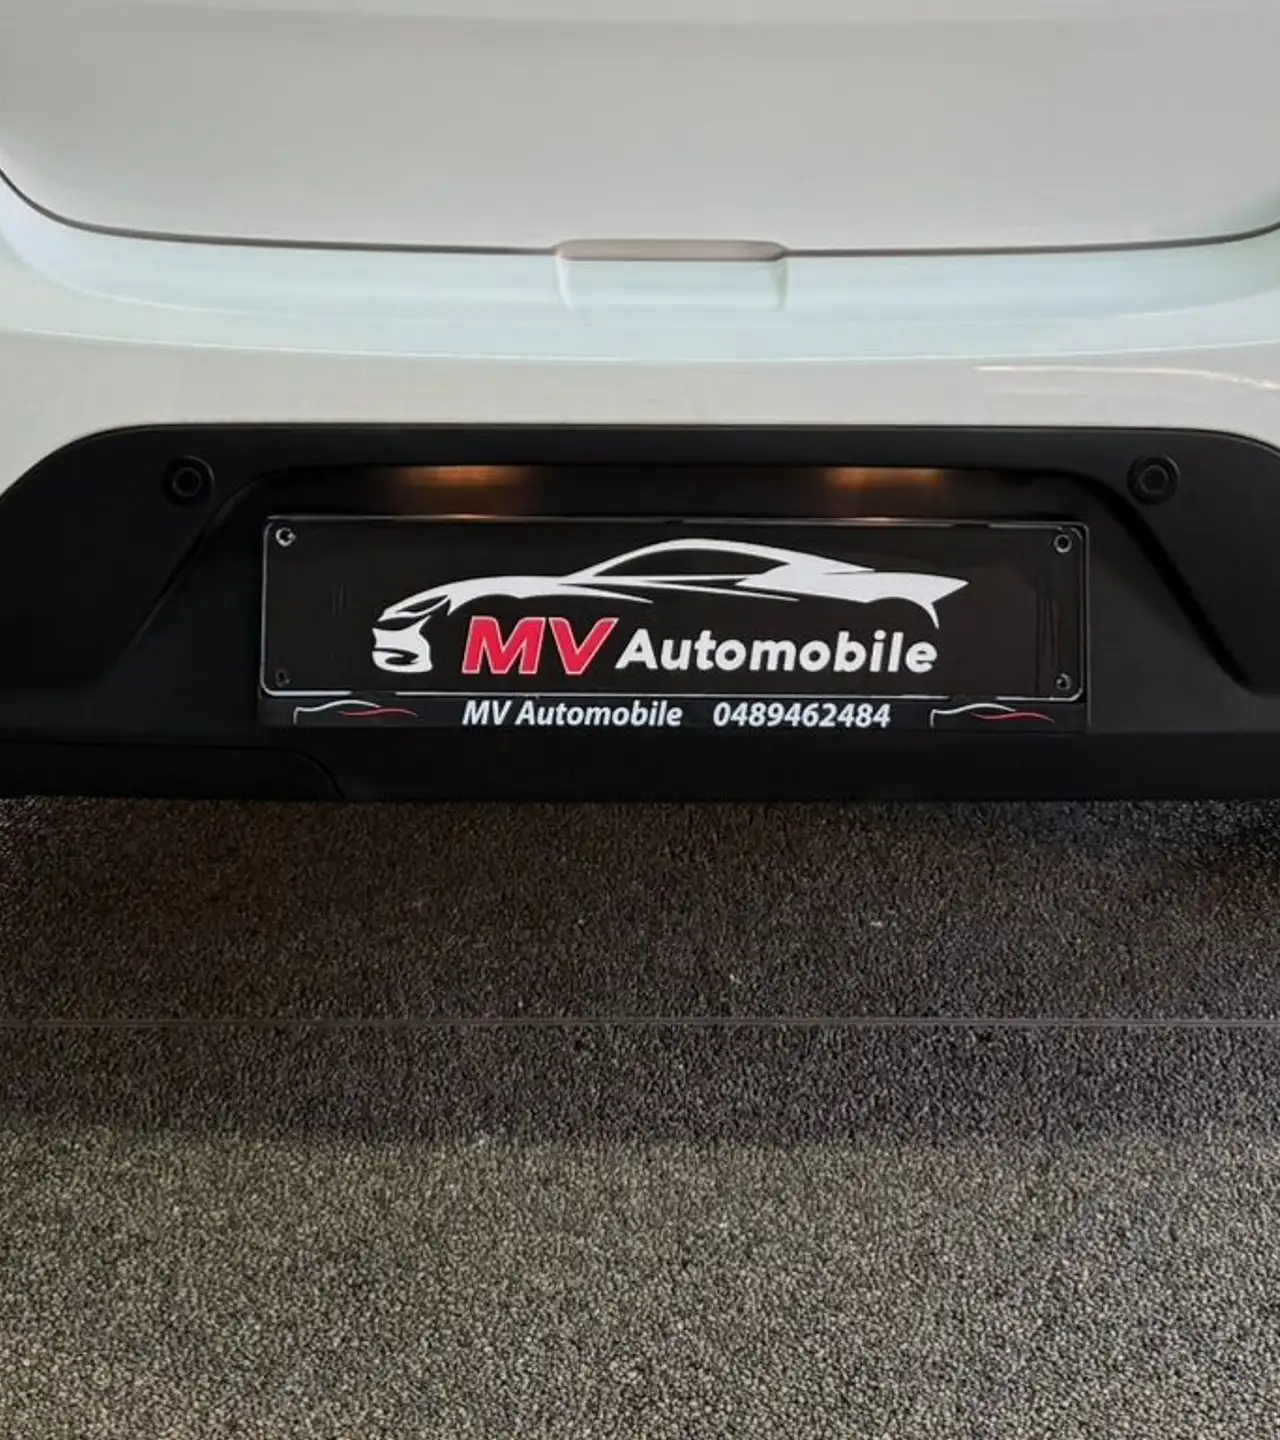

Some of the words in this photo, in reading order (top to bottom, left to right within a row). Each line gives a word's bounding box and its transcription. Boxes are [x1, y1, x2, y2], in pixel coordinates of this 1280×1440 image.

[461, 616, 619, 676] MV
[615, 628, 939, 674] Automobile
[461, 700, 513, 727] MV
[515, 699, 684, 728] Automobile
[712, 702, 892, 729] 0489462484
